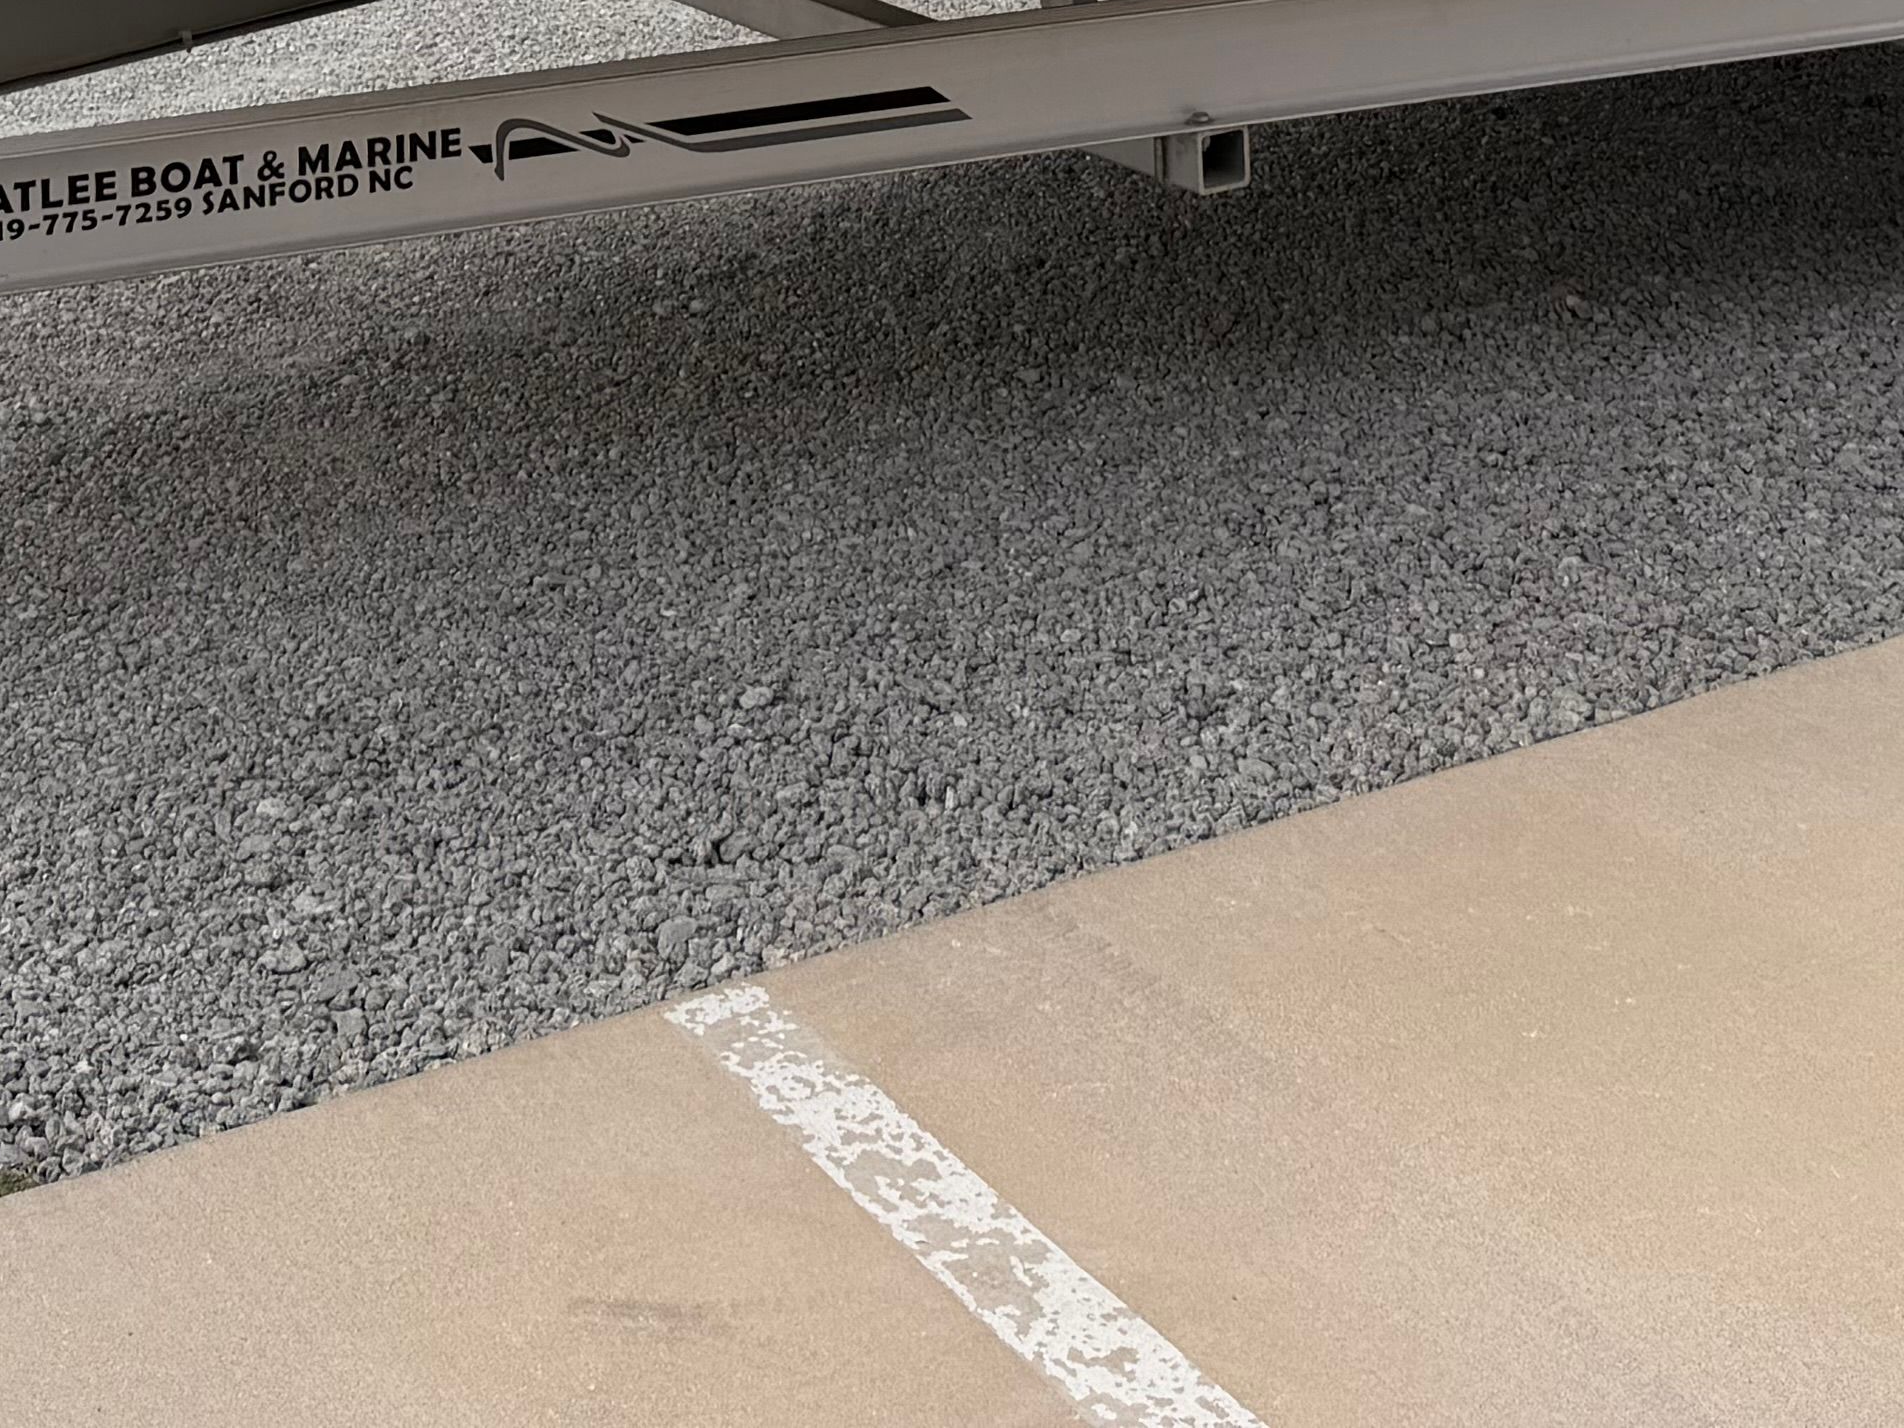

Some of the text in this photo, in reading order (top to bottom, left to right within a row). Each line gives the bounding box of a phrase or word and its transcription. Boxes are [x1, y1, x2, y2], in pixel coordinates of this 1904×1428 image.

[131, 154, 244, 198] BOAT
[257, 150, 285, 183] &
[298, 127, 463, 177] MARINE
[202, 174, 360, 216] SANFORD
[369, 165, 414, 194] NC
